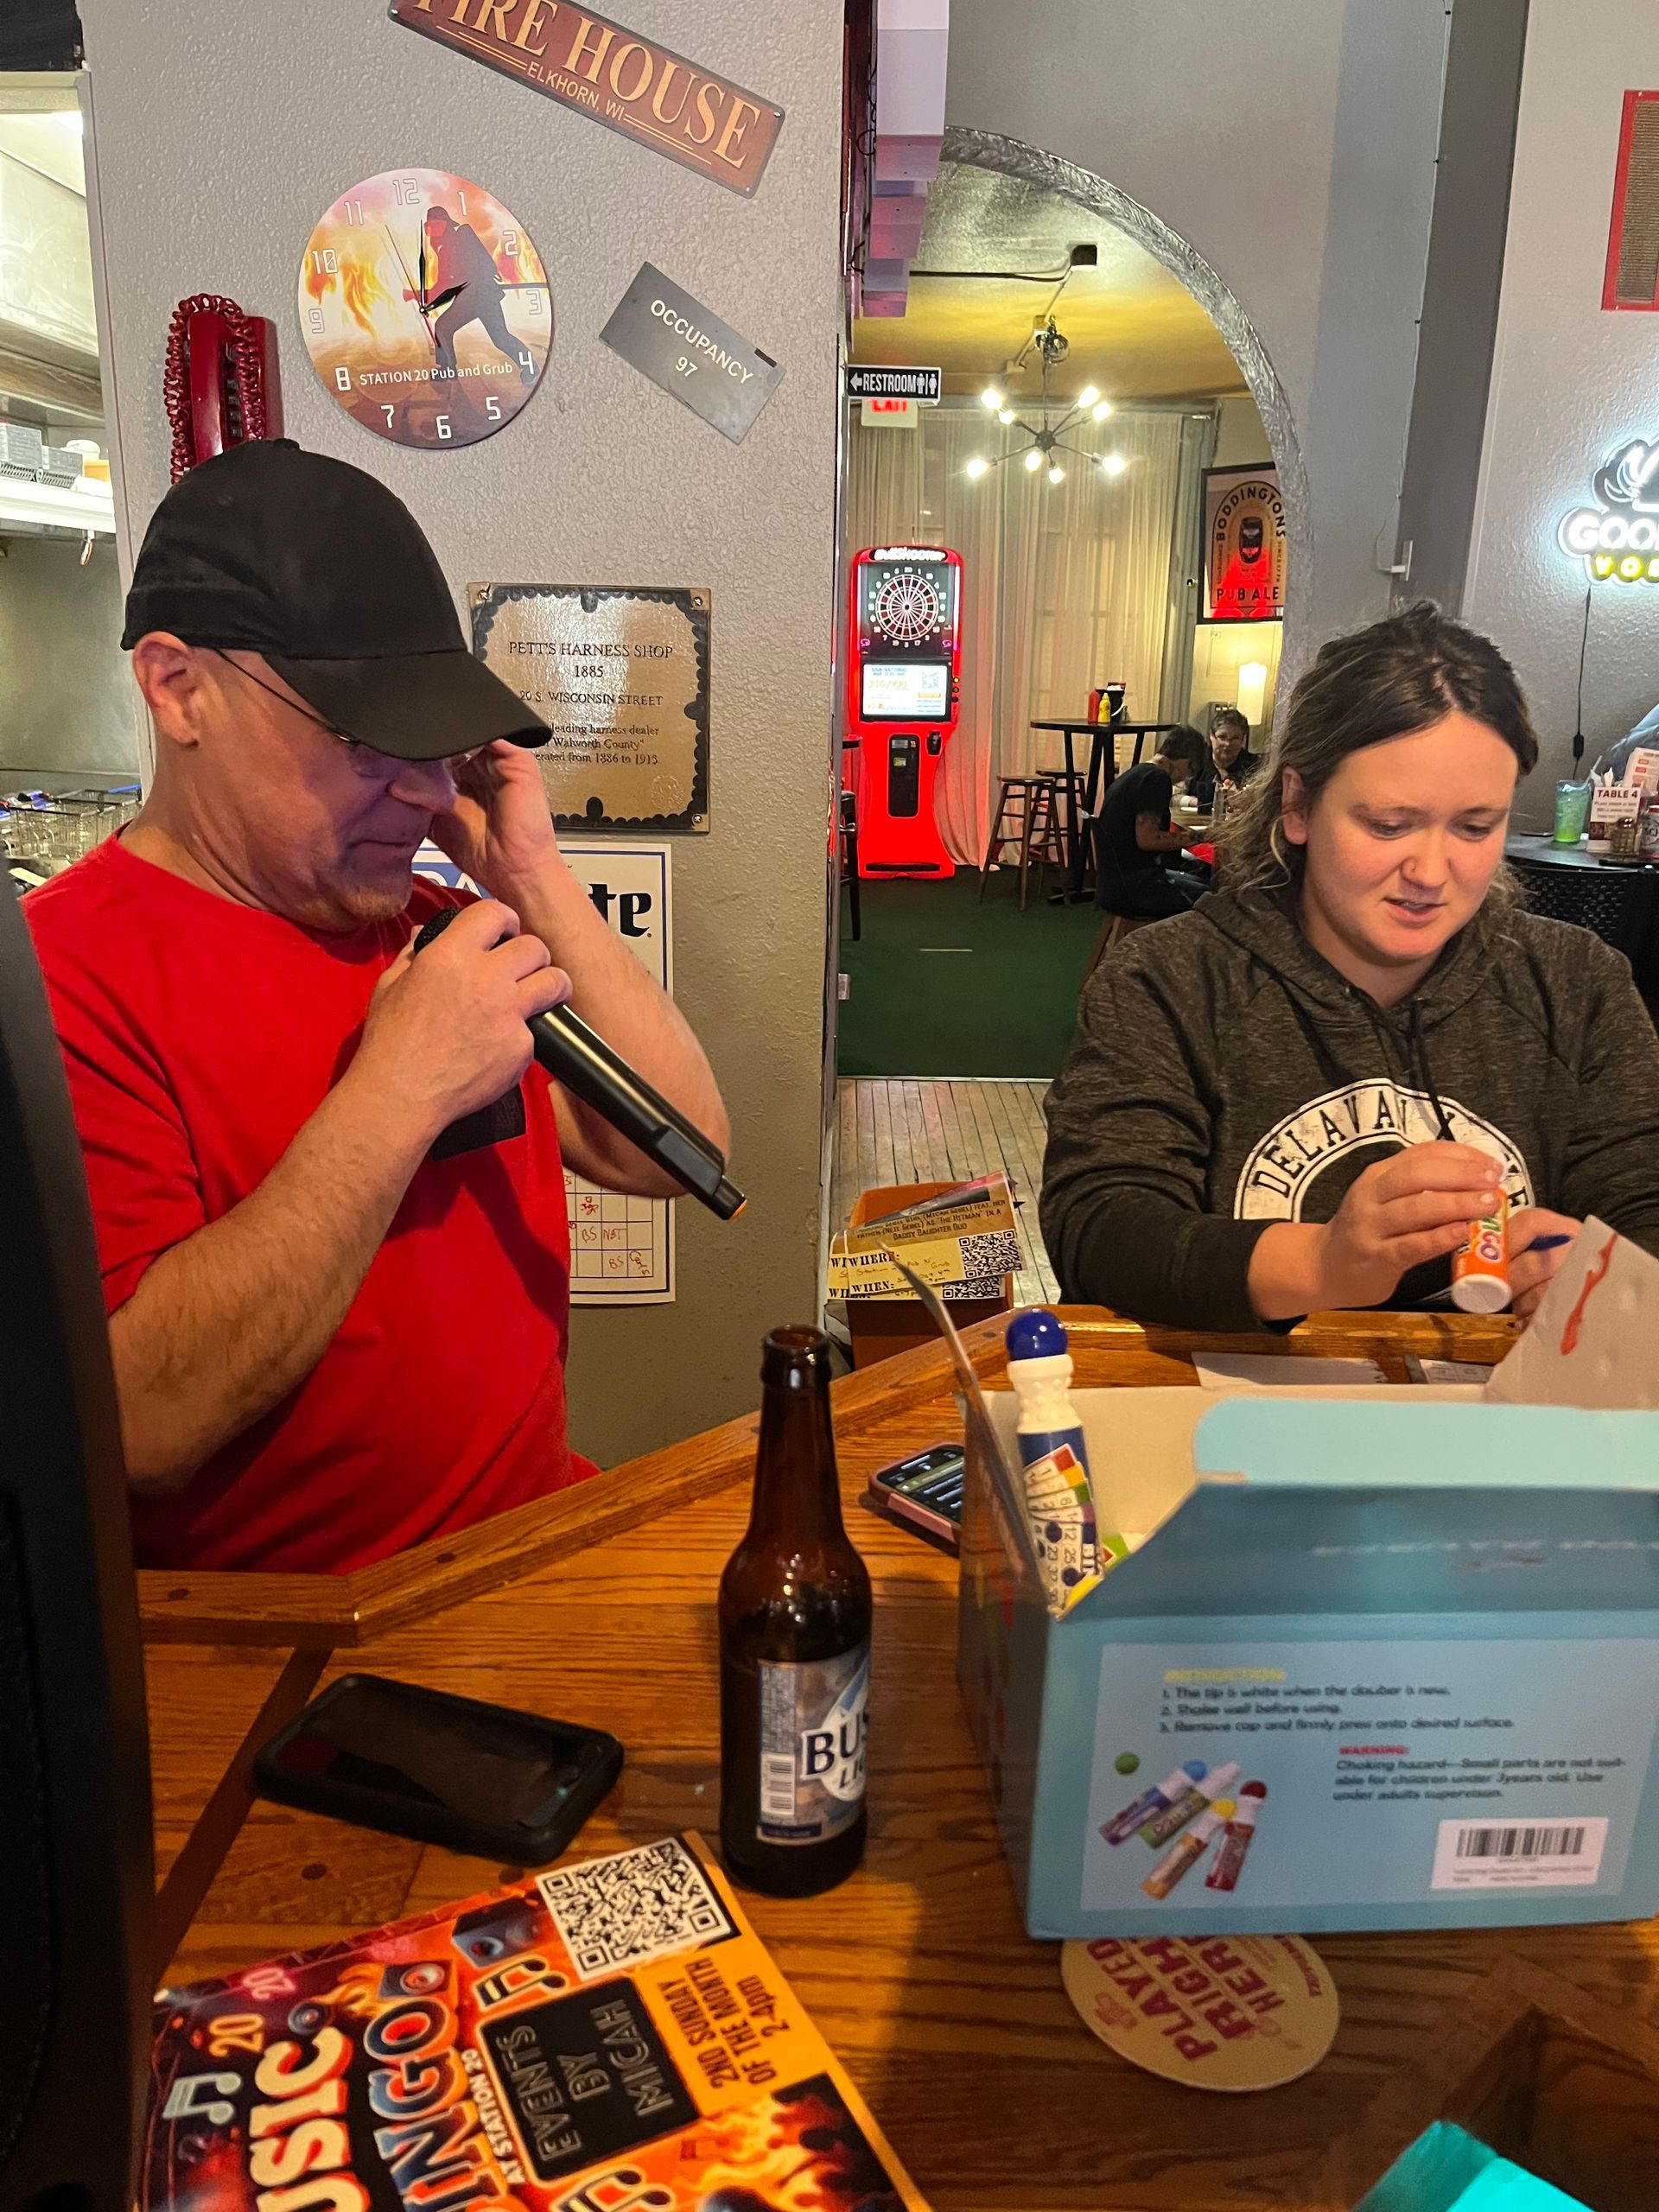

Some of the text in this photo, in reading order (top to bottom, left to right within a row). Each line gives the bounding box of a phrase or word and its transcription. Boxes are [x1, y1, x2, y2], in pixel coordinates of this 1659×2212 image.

[413, 0, 760, 168] IRE HOUSE
[526, 61, 625, 121] ELKHORN, WI
[393, 178, 420, 205] 12
[458, 191, 467, 215] 1
[344, 200, 365, 226] 11
[503, 231, 518, 256] 2
[312, 249, 338, 274] 10
[526, 289, 543, 315] 3
[308, 308, 325, 334] 9
[650, 298, 753, 385] OCCUPANCY
[359, 362, 512, 385] STATION 20 Pub and Grub
[518, 351, 534, 374] 4
[675, 356, 699, 378] 97
[335, 366, 352, 391] 8
[862, 372, 917, 393] RESTROOM
[381, 404, 395, 428] 7
[486, 397, 501, 420] 5
[436, 416, 452, 439] 6
[1216, 486, 1286, 542] BODDINGTONS
[1568, 515, 1659, 550] GOO
[1217, 586, 1279, 601] PUB ALE
[509, 642, 672, 658] PETT'S HARNESS SHOP
[574, 665, 604, 677] 1885
[548, 692, 614, 704] WISCONSIN
[618, 695, 664, 706] STREET
[589, 723, 626, 734] harness
[629, 725, 659, 735] dealer
[553, 737, 601, 749] Walworth
[535, 752, 565, 761] erated
[569, 753, 591, 763] from
[621, 754, 632, 763] to
[1598, 790, 1638, 798] TABLE 4
[851, 1281, 894, 1293] WHEN:
[1176, 1688, 1200, 1699] The
[1205, 1688, 1224, 1700] tip
[1240, 1687, 1279, 1698] white
[1283, 1686, 1321, 1697] when
[1325, 1685, 1347, 1696] the
[1177, 1704, 1219, 1715] Shake
[1224, 1703, 1251, 1714] well
[1255, 1703, 1300, 1714] before
[1174, 1719, 1230, 1732] Remove
[1236, 1721, 1261, 1732] cap
[1264, 1719, 1292, 1731] and
[1296, 1719, 1334, 1732] firmly
[1411, 1717, 1460, 1729] desired
[806, 1713, 867, 1776] BU
[1337, 1759, 1395, 1771] Choking
[1503, 1758, 1540, 1770] parts
[1368, 1774, 1388, 1784] for
[1391, 1774, 1447, 1785] children
[1452, 1774, 1492, 1784] under
[1332, 1790, 1373, 1801] under
[243, 1967, 296, 2000] 20
[1129, 1938, 1255, 2040] RIGH
[1087, 1938, 1218, 2061] PLAYED
[684, 1956, 777, 2084] OF THE MONTH
[209, 2013, 264, 2057] 20
[658, 1978, 741, 2088] 2ND SUNDAY
[589, 1999, 674, 2117] MICAH
[556, 2052, 611, 2101] BY
[364, 1997, 508, 2212] INGO
[495, 2024, 582, 2162] EVENTS
[250, 2024, 368, 2212] USIC
[461, 2049, 525, 2183] AT STATION 20
